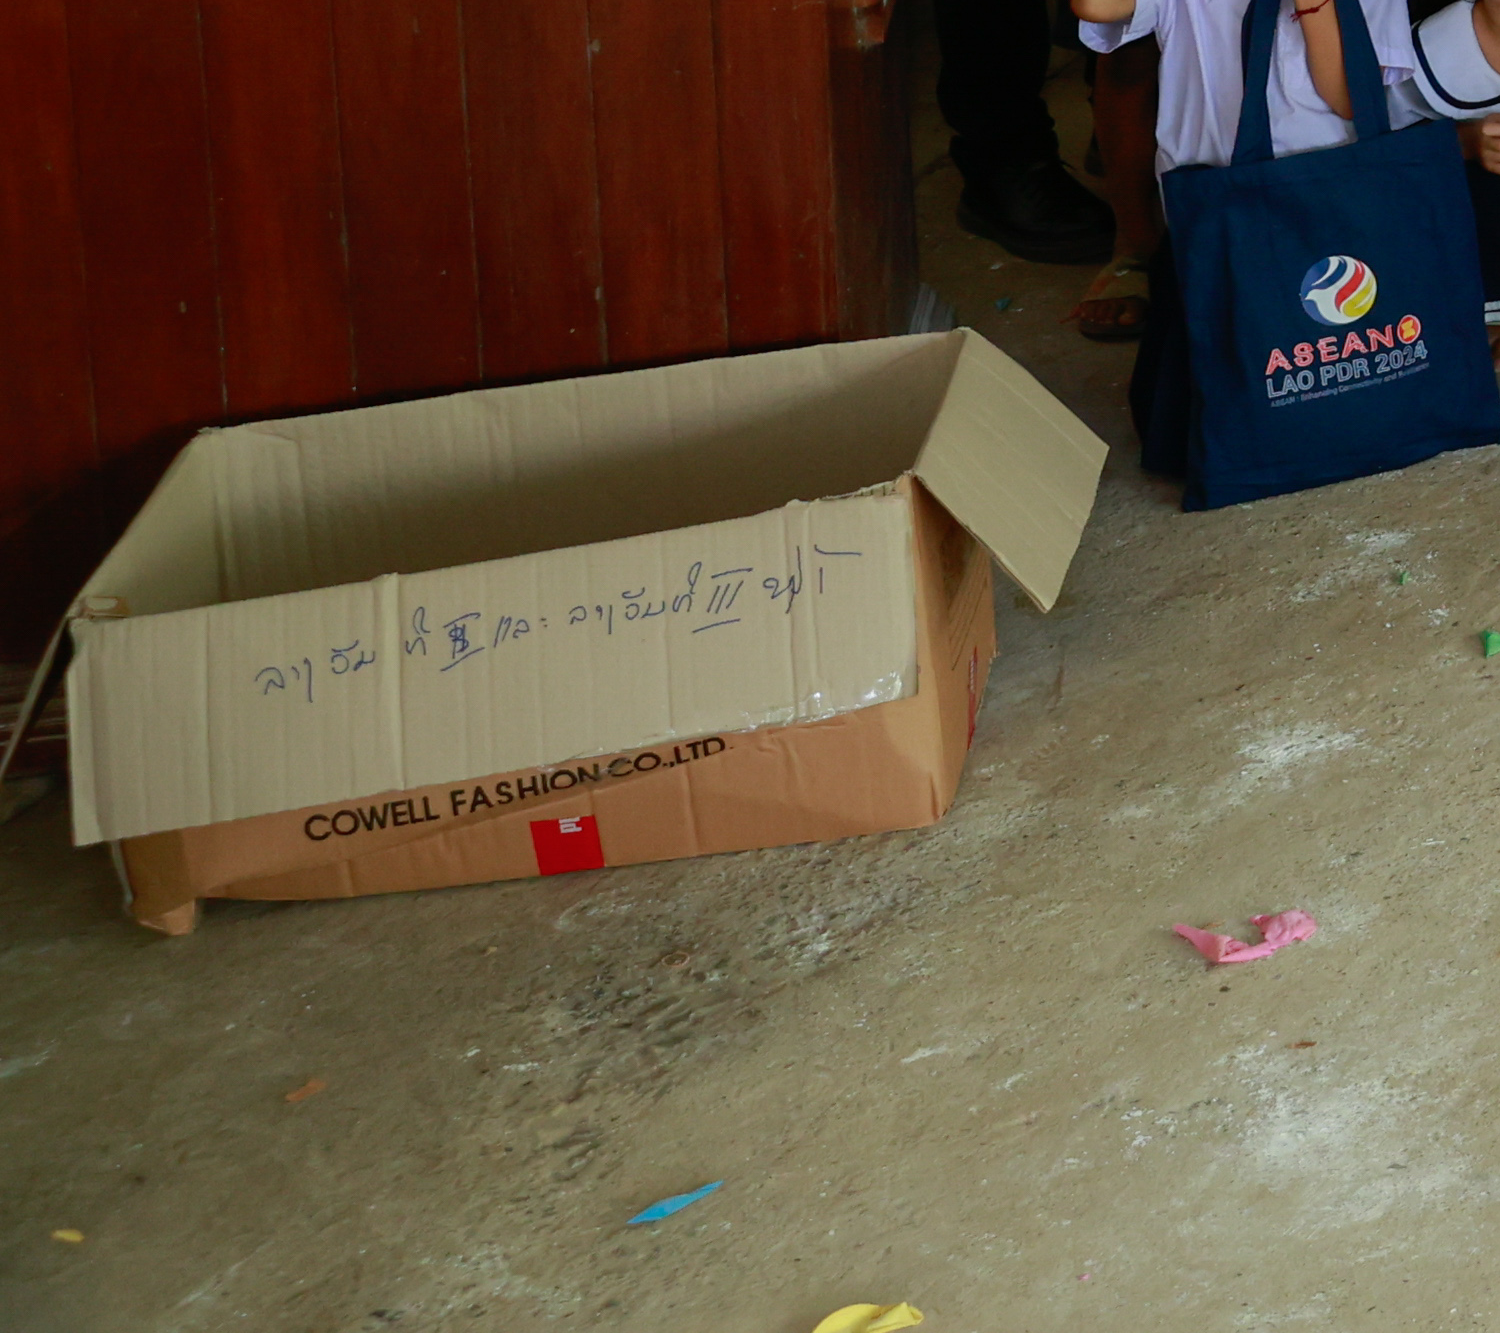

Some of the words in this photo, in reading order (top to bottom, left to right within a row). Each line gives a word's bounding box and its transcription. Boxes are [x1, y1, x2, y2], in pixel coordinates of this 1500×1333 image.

[1265, 324, 1395, 376] ASEAN
[1266, 363, 1316, 399] LAO
[1320, 356, 1371, 395] PDR
[1375, 339, 1429, 374] 2024
[303, 795, 441, 841] COWELL
[450, 761, 601, 818] FASHION
